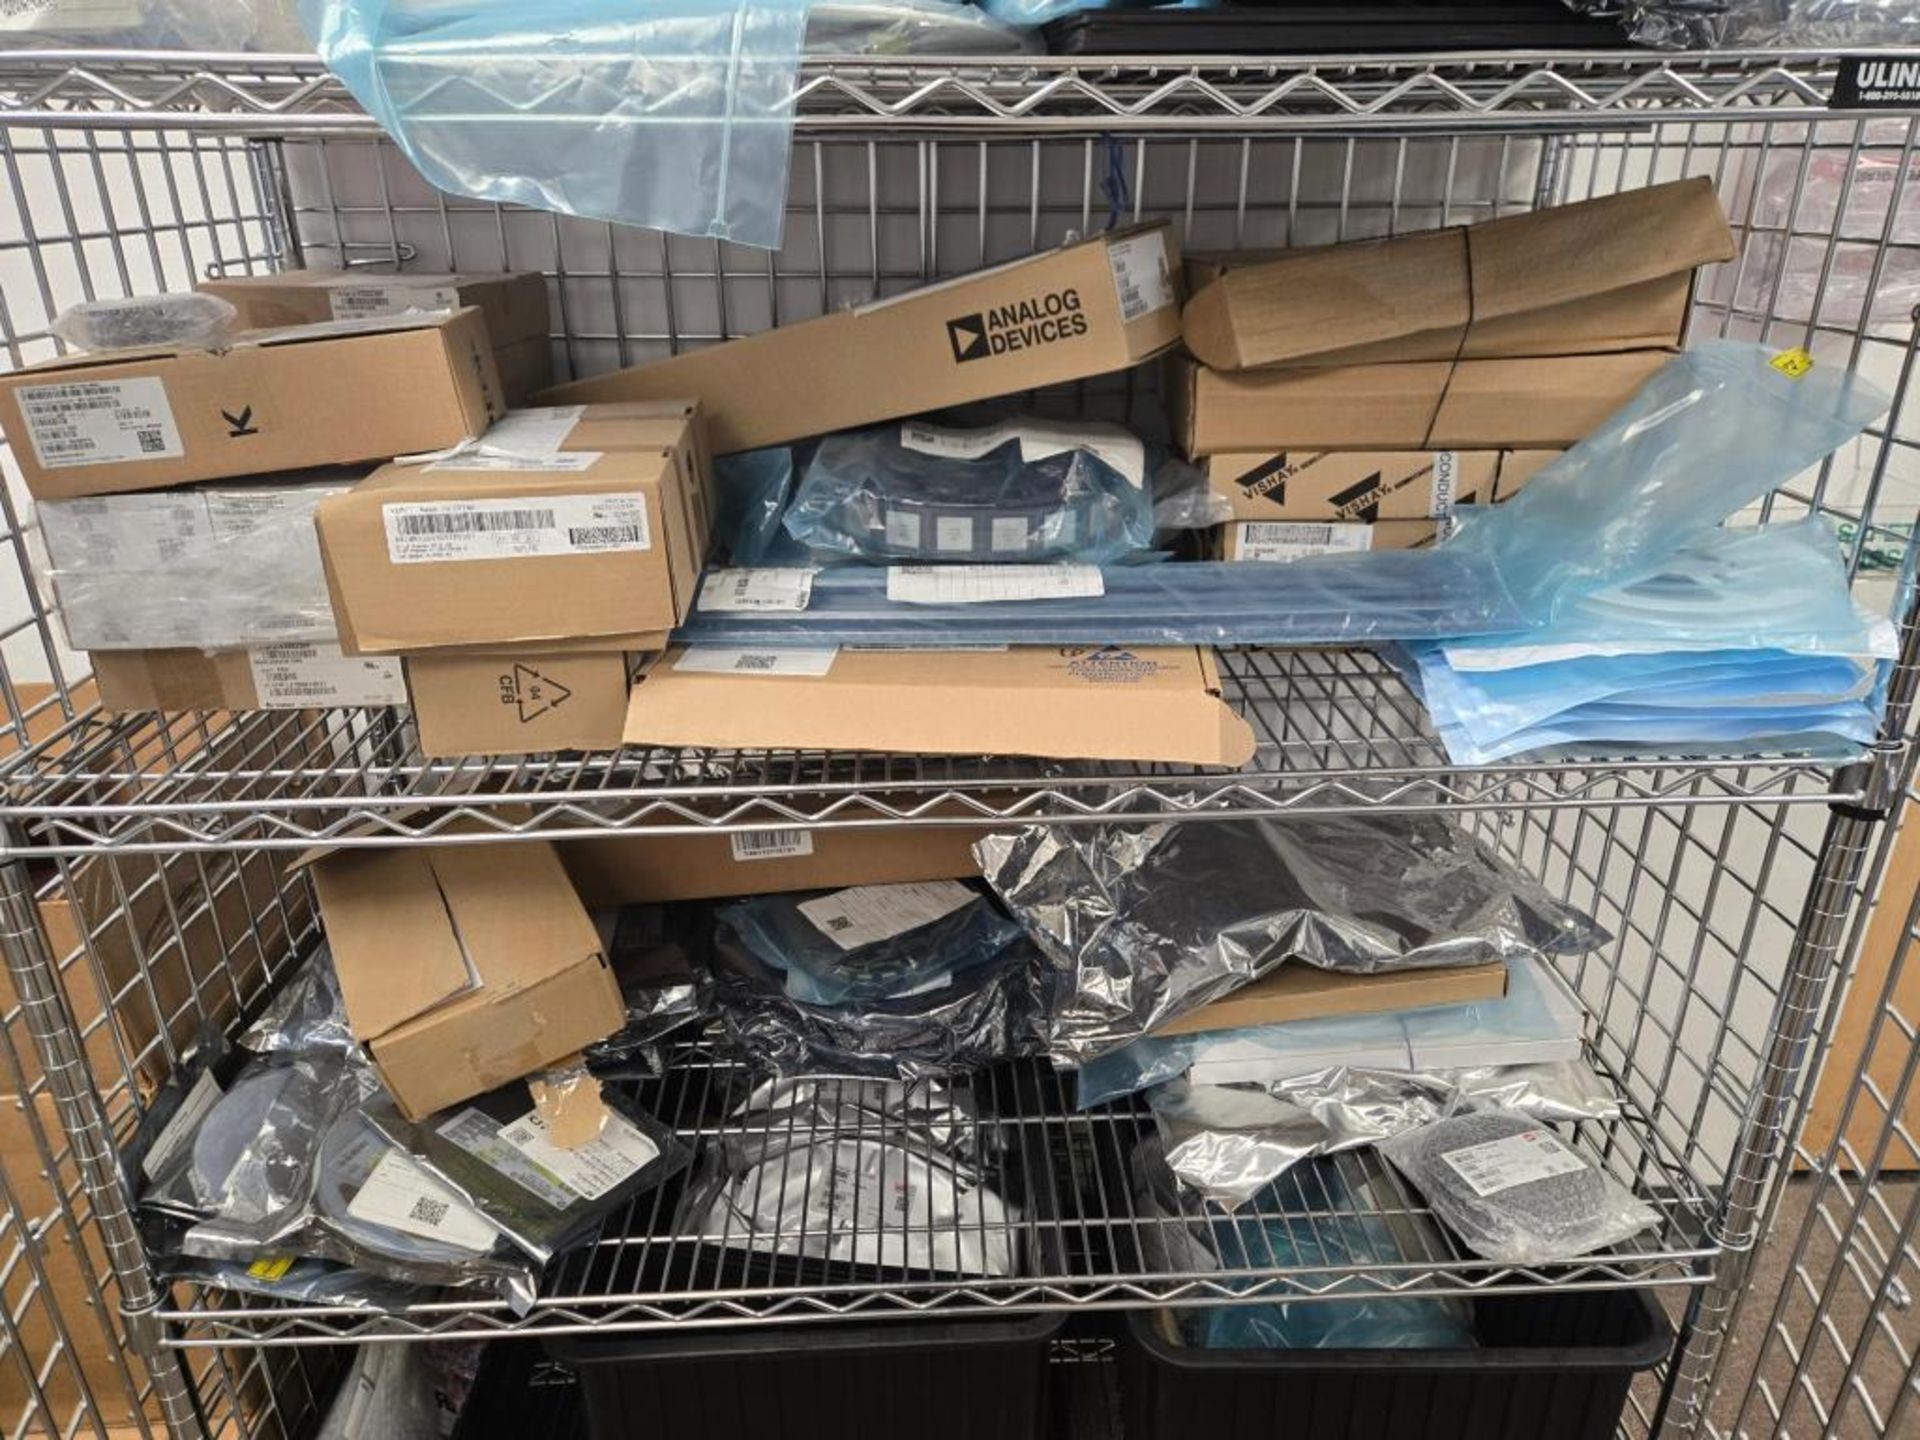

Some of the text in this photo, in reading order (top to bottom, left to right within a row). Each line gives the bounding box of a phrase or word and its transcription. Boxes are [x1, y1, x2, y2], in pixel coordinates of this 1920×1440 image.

[988, 289, 1081, 331] ANALOG
[990, 313, 1088, 356] DEVICES
[499, 675, 515, 704] CFB
